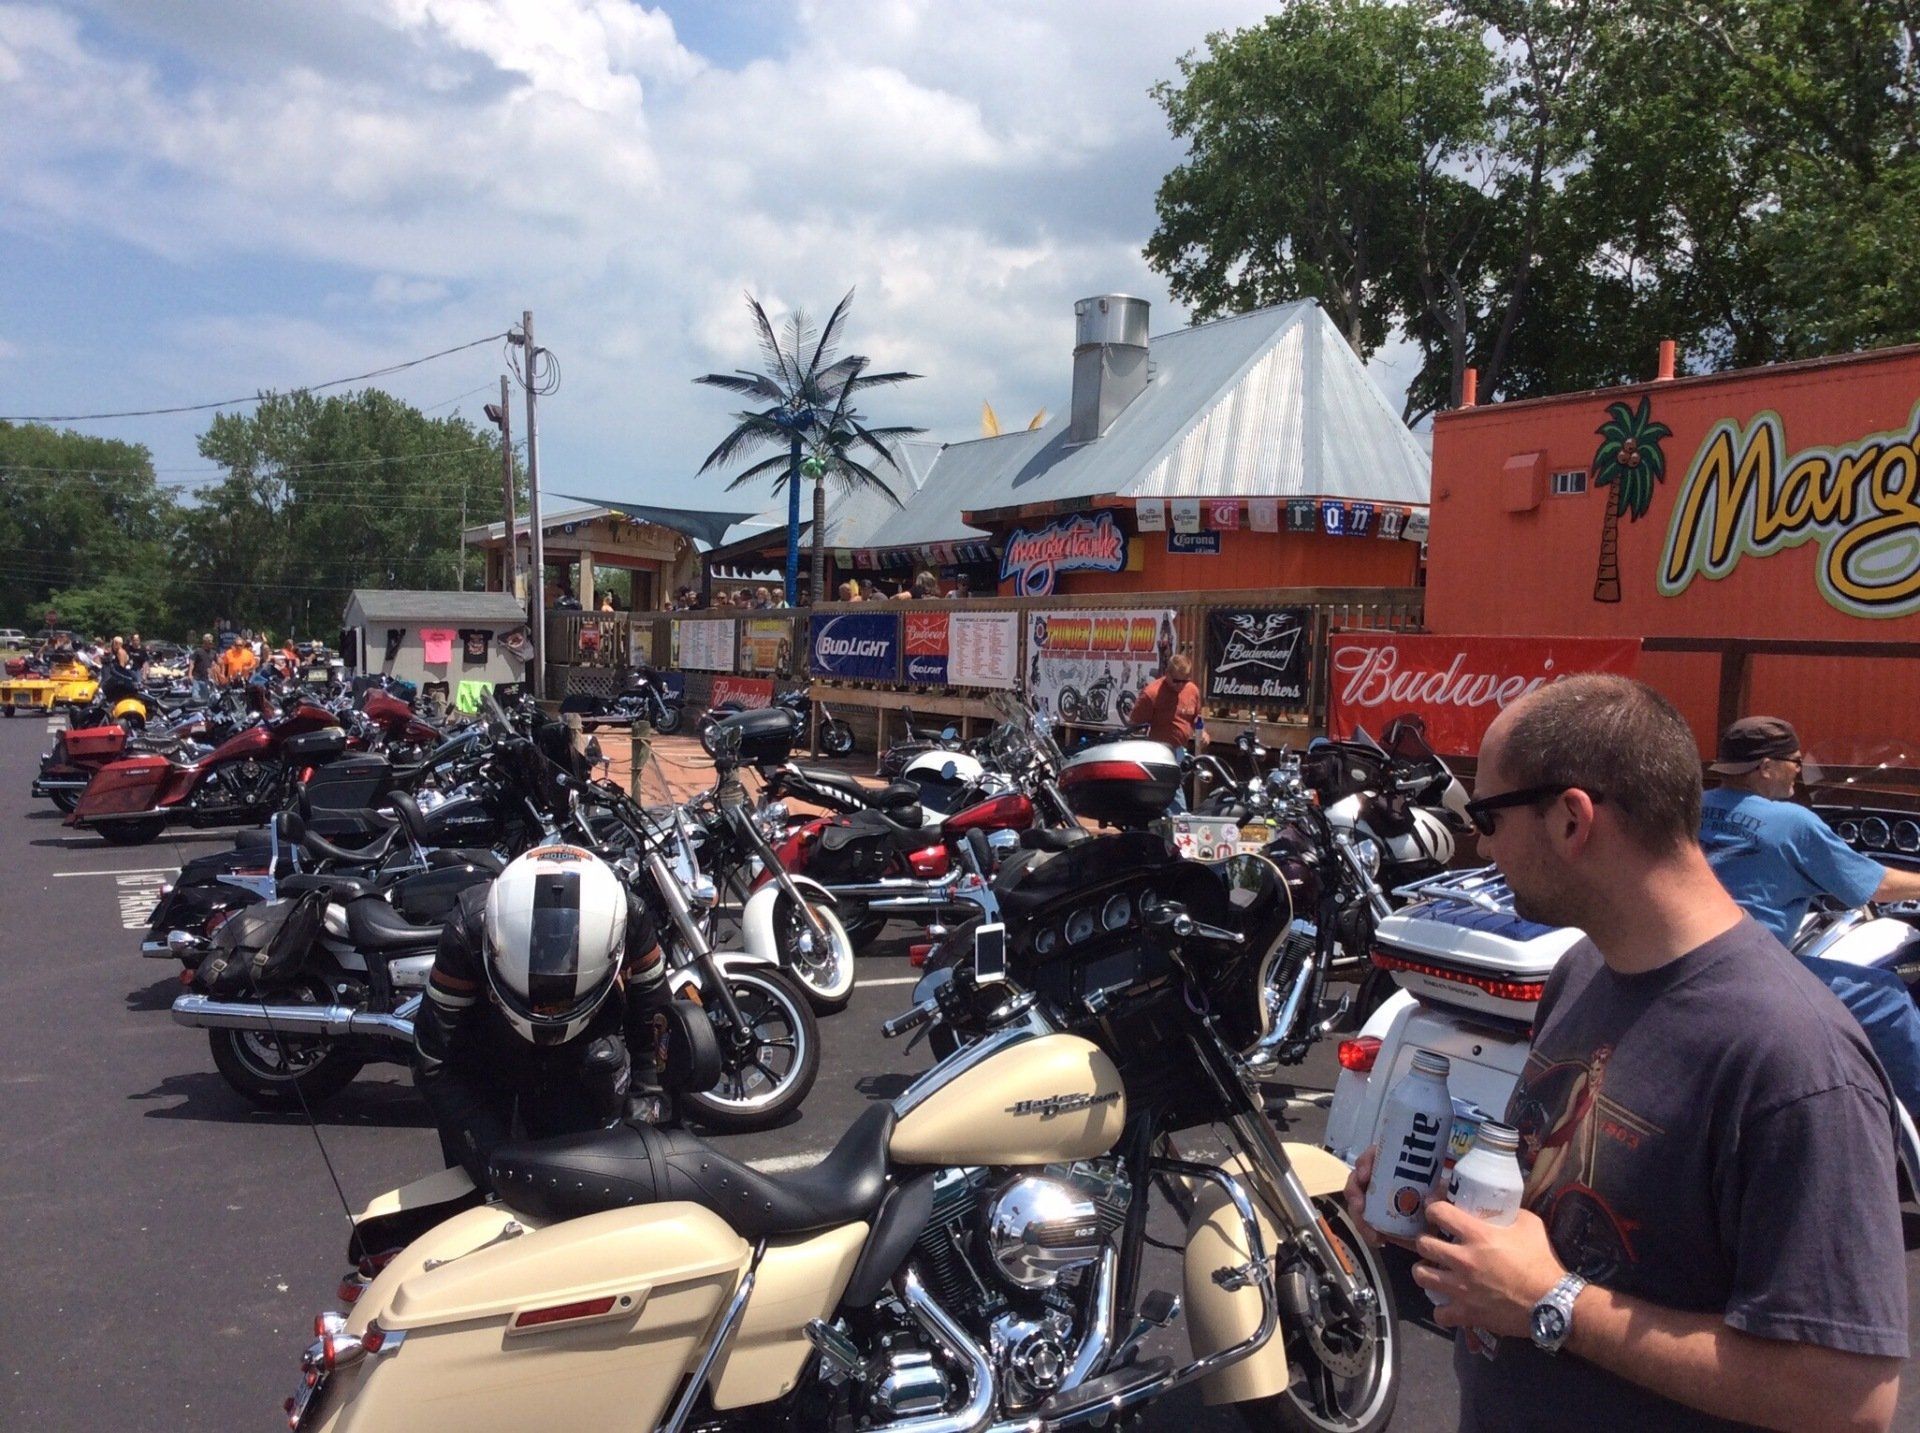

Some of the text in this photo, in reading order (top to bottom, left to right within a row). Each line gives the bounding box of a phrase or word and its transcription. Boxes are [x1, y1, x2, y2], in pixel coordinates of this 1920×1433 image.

[1666, 420, 1920, 605] Marg
[1173, 534, 1215, 547] Corona
[1228, 643, 1290, 660] Budweiser
[1213, 676, 1301, 697] Welcome Bikers
[1334, 646, 1568, 708] Budwei
